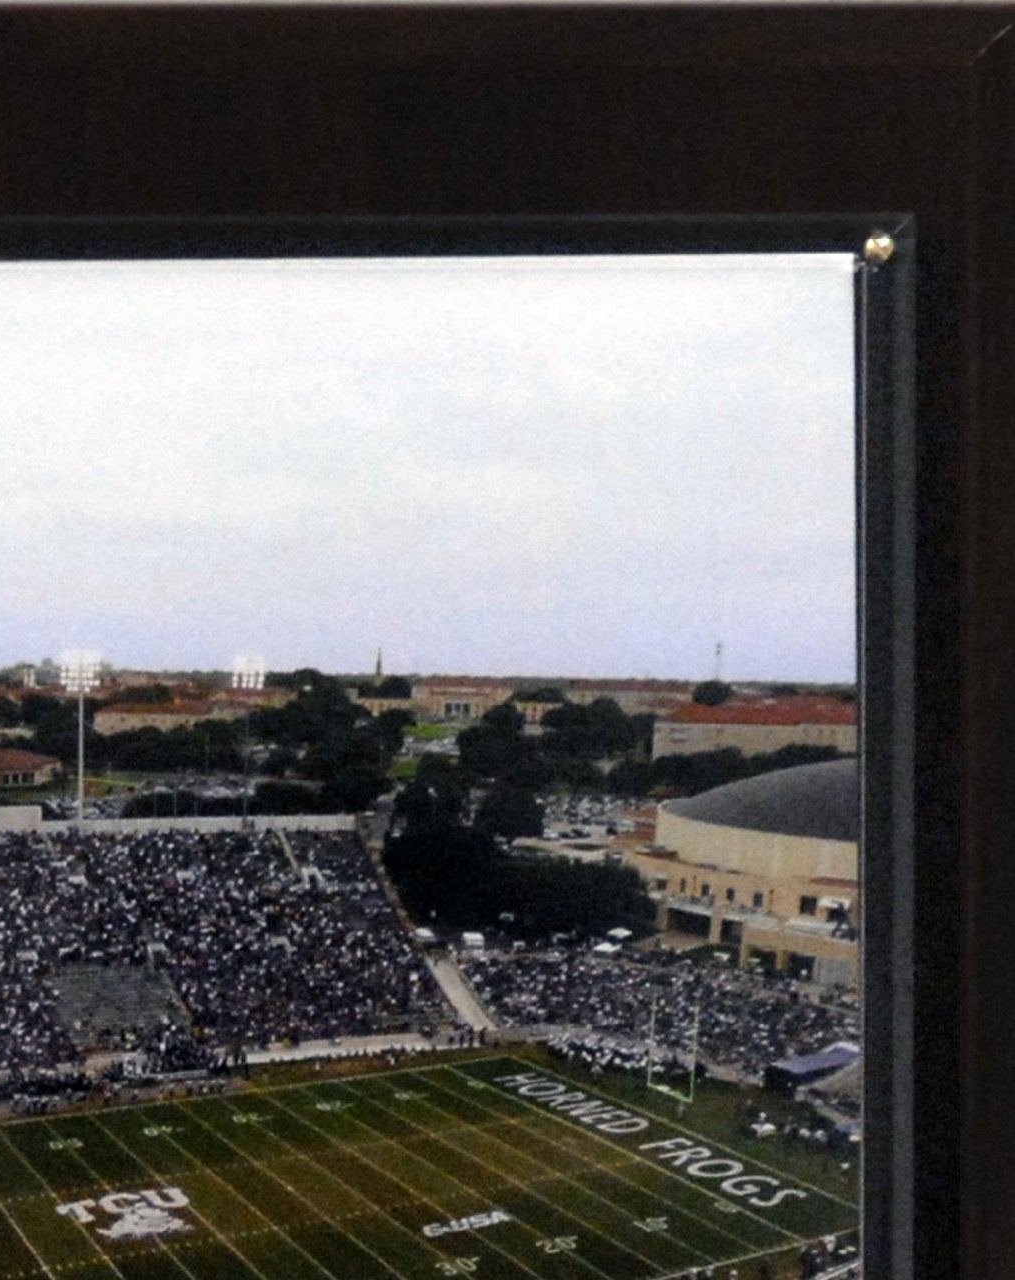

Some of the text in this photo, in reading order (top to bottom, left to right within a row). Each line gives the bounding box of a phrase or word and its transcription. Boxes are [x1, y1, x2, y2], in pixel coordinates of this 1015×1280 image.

[493, 1072, 807, 1208] HORNED FROGS
[55, 1187, 189, 1223] TCU
